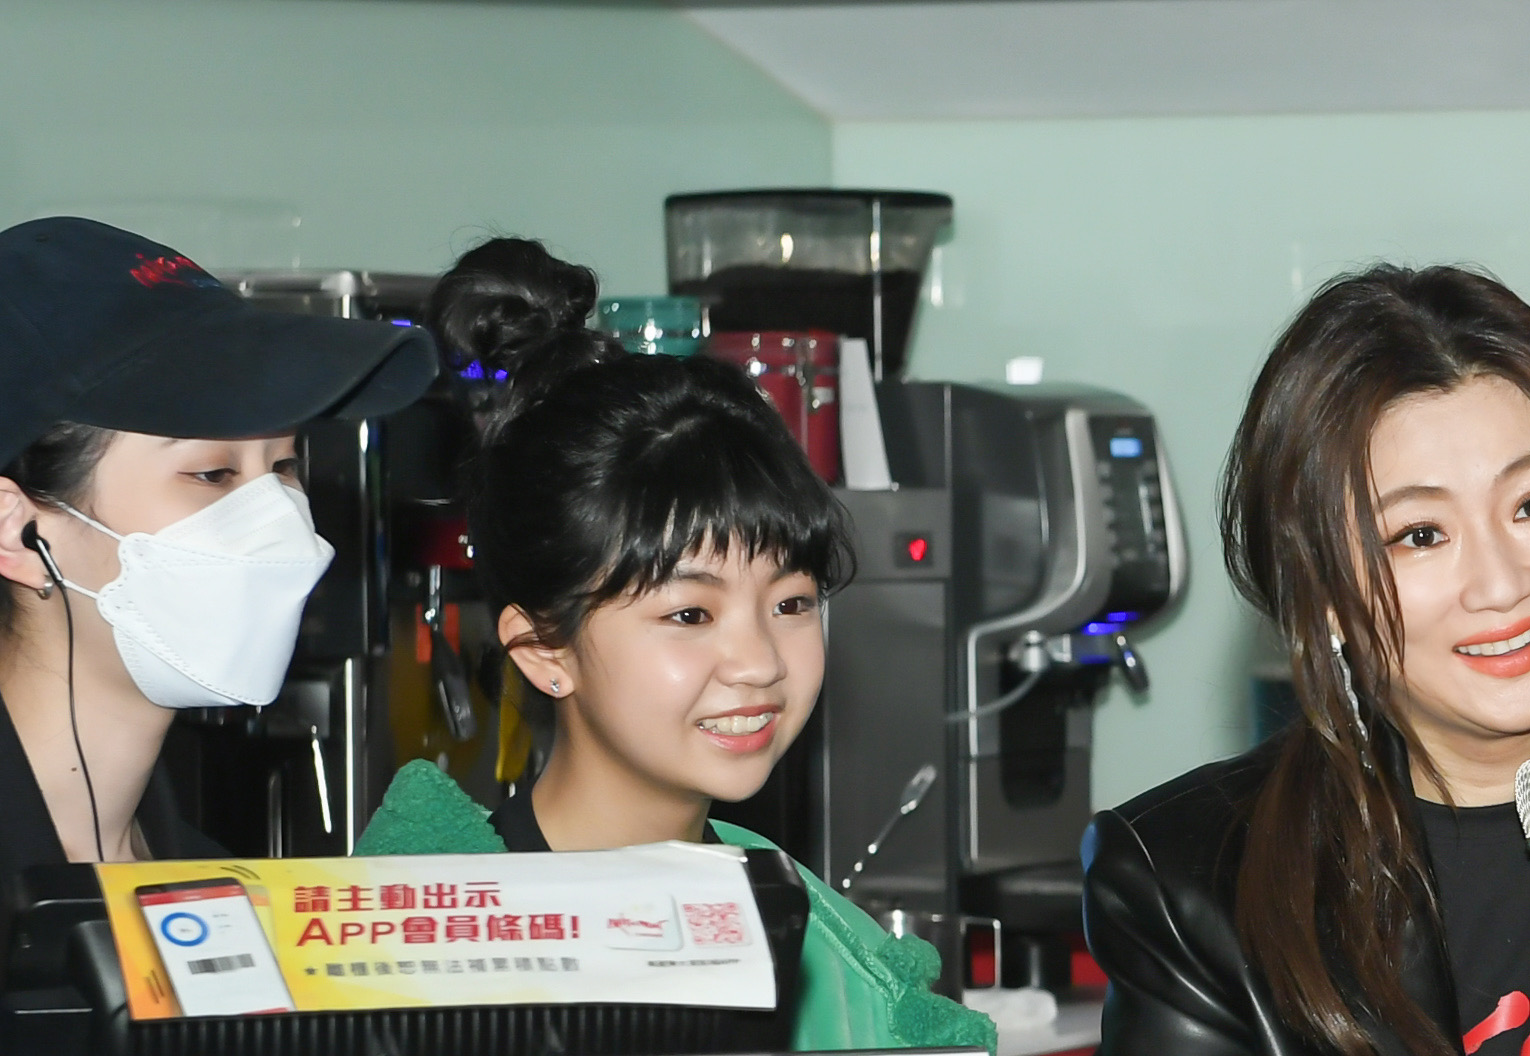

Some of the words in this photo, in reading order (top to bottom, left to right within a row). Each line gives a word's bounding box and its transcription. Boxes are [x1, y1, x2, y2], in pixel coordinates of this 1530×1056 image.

[294, 881, 502, 913] 請主動出示
[296, 914, 580, 947] APP會員條碼!
